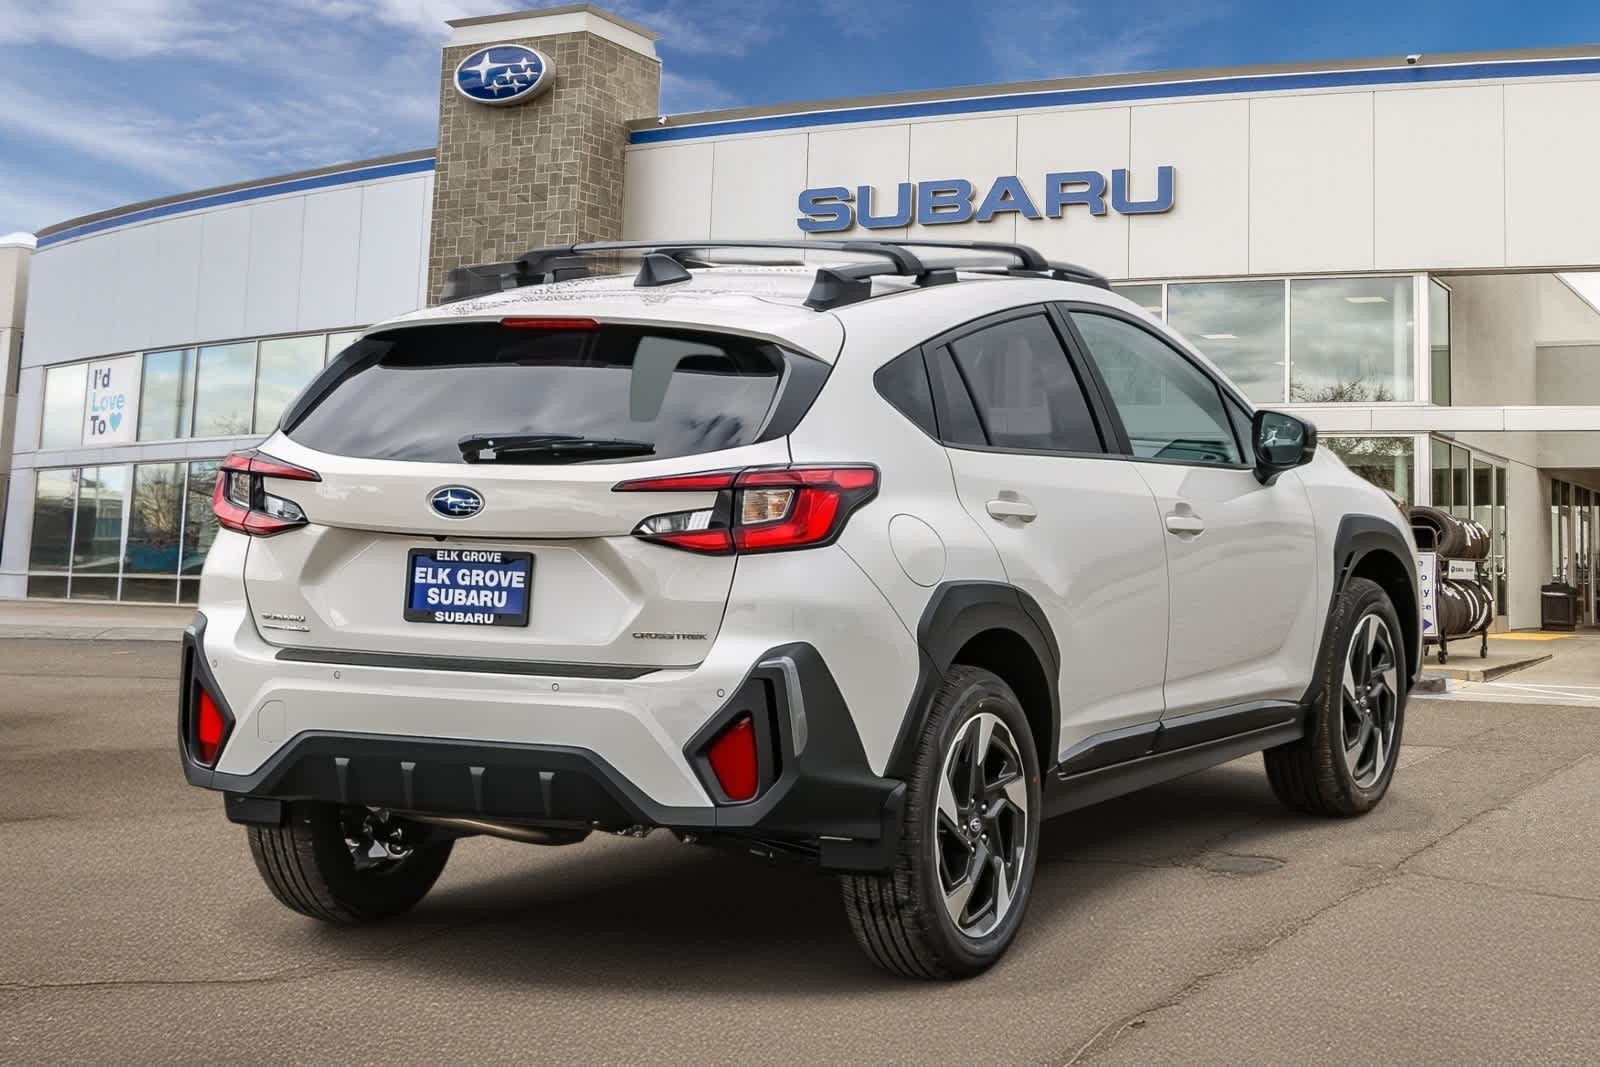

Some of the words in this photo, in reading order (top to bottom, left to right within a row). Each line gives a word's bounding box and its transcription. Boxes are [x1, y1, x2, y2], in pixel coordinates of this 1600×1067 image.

[797, 165, 1175, 233] SUBARU
[94, 368, 111, 389] I'd
[92, 392, 125, 412] Love
[90, 415, 106, 435] To
[436, 550, 459, 561] ELK
[462, 551, 502, 563] GROVE
[414, 567, 451, 584] ELK
[456, 569, 526, 588] GROVE
[427, 587, 507, 607] SUBARU
[434, 611, 494, 624] SUBARU
